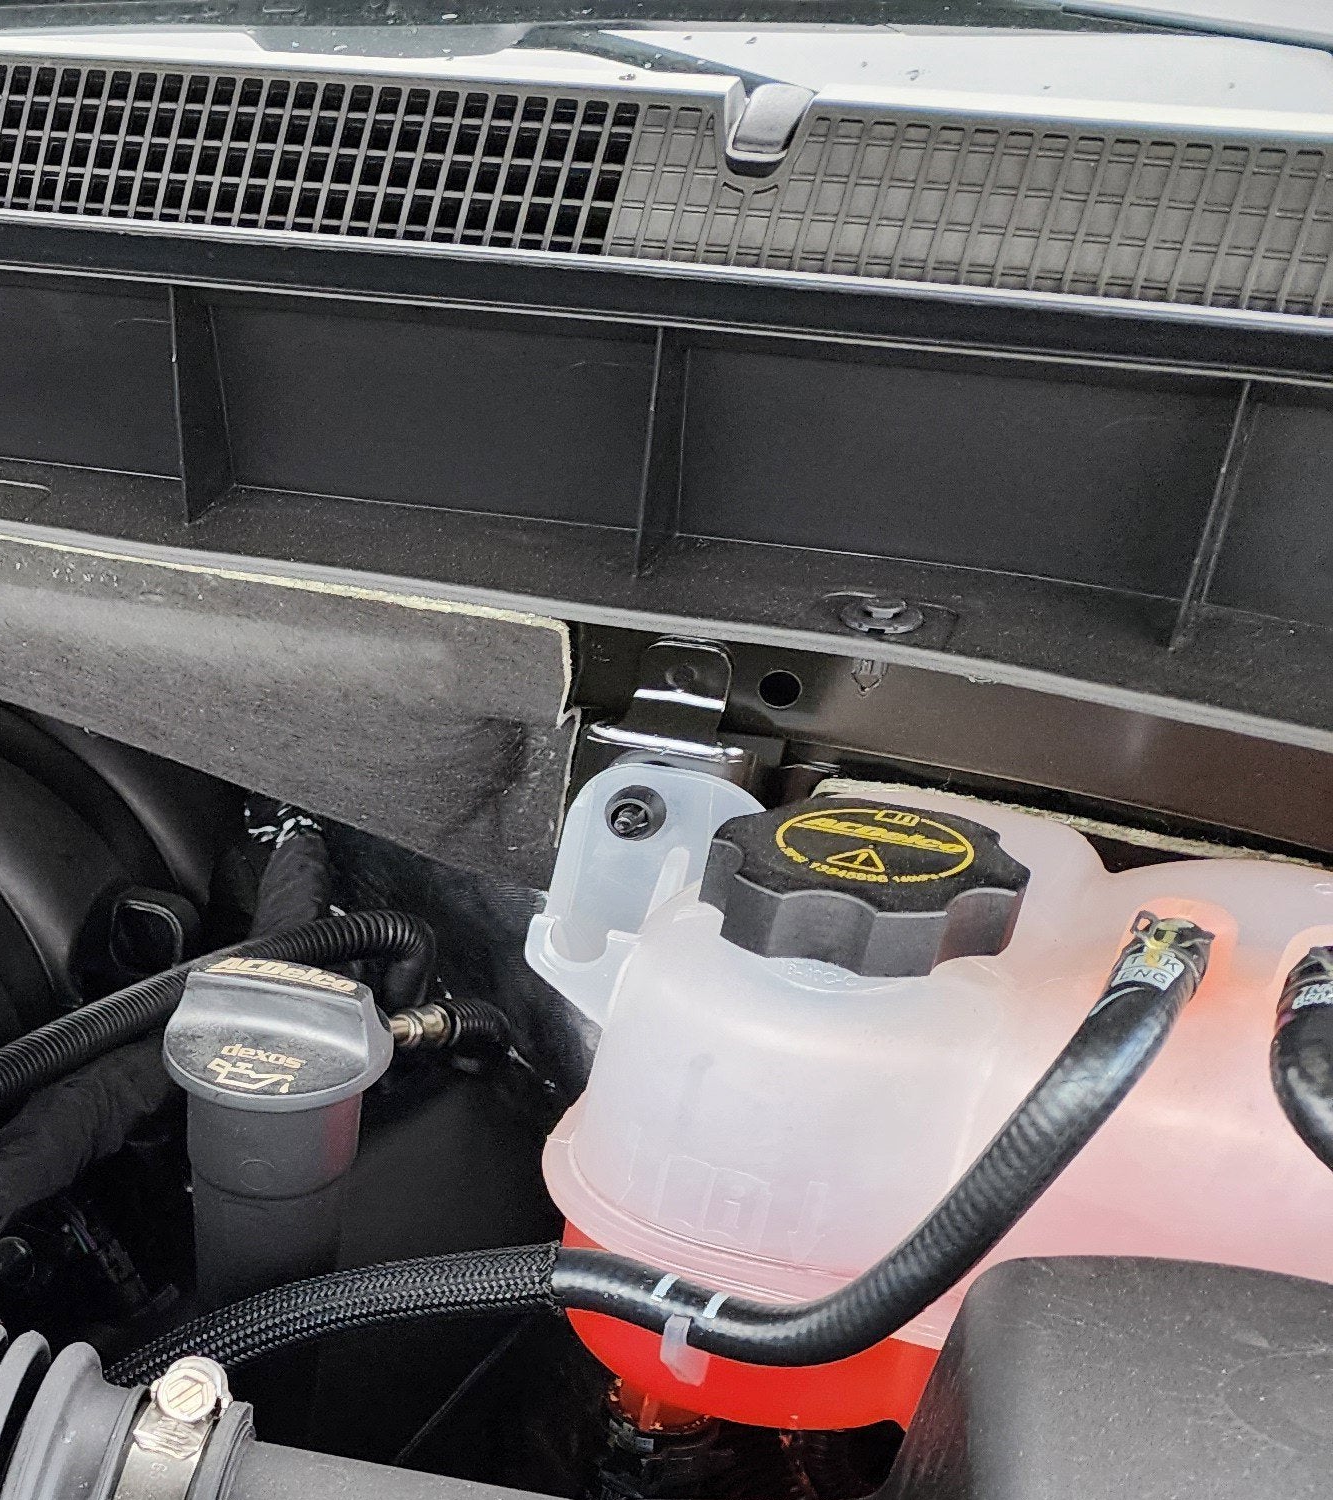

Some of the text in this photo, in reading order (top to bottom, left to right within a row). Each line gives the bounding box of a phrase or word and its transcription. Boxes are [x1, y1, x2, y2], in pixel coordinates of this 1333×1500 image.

[206, 957, 358, 994] ACDelco
[1119, 969, 1169, 985] ENG
[221, 1043, 308, 1069] dexos
